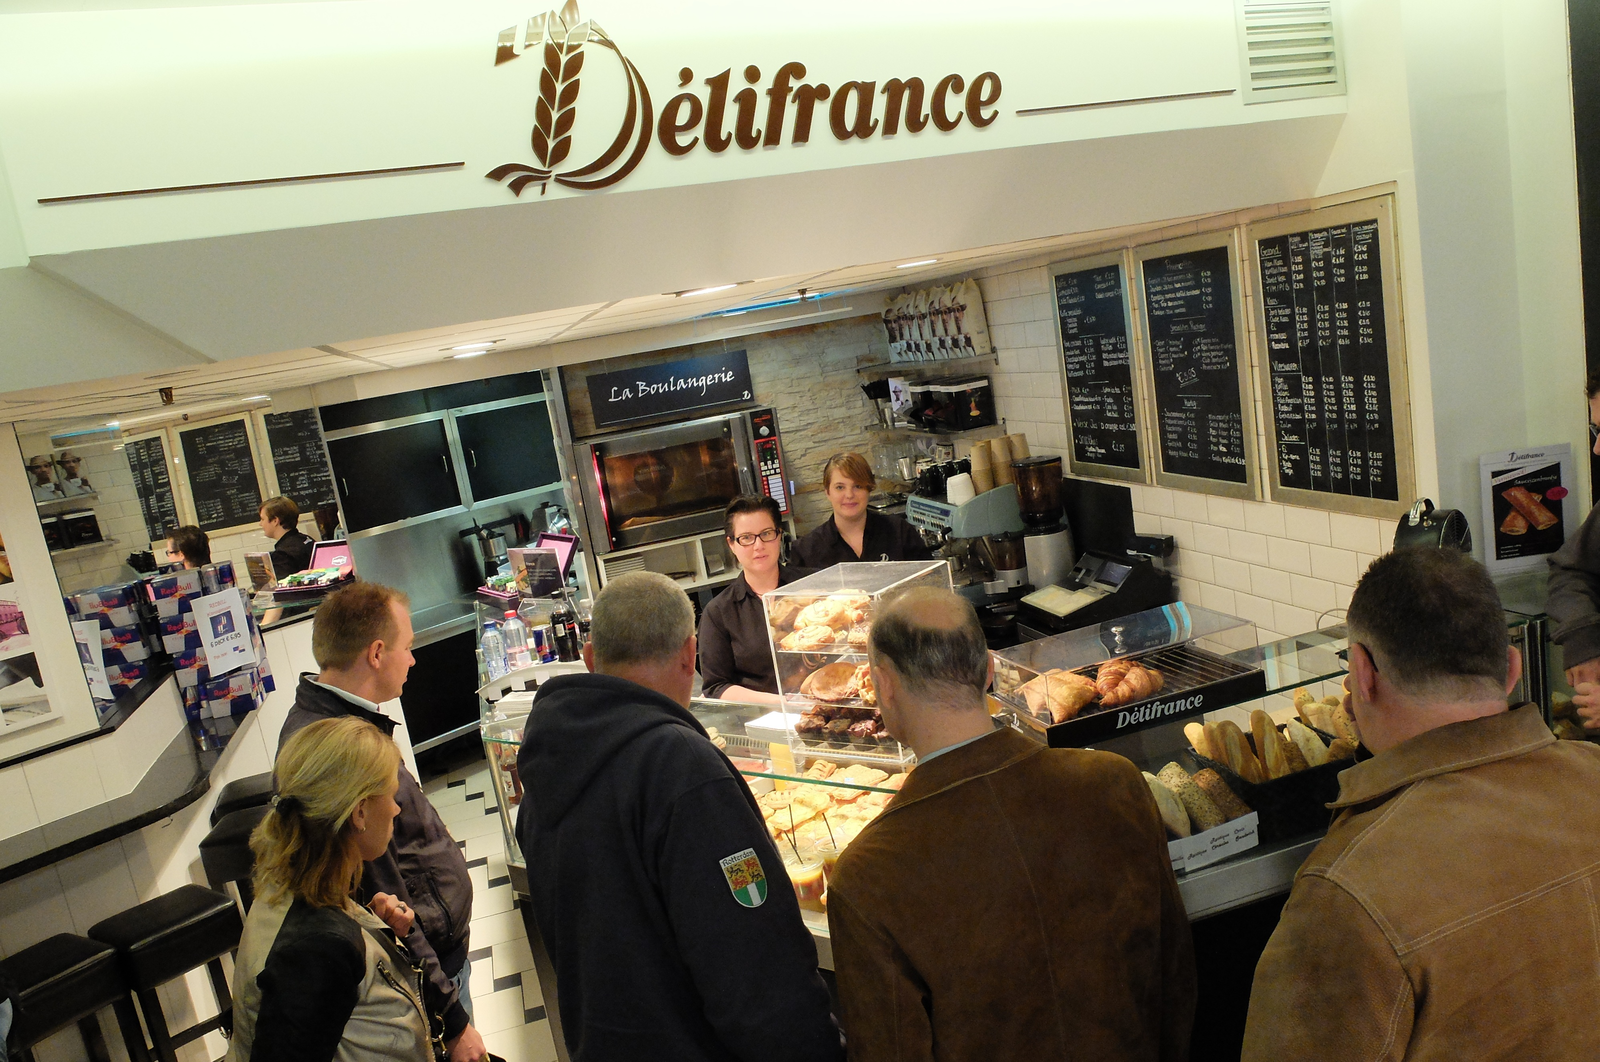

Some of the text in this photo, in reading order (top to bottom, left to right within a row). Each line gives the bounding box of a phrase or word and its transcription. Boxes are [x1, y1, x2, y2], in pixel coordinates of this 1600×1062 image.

[485, 0, 1003, 196] Délifrance
[608, 366, 735, 402] La Boulangerie
[160, 582, 192, 595] Red Bull
[167, 622, 183, 631] Red
[180, 658, 195, 666] Red
[213, 685, 243, 697] Red Bull
[1115, 693, 1204, 730] Délifrance
[721, 850, 755, 867] Rotterdam
